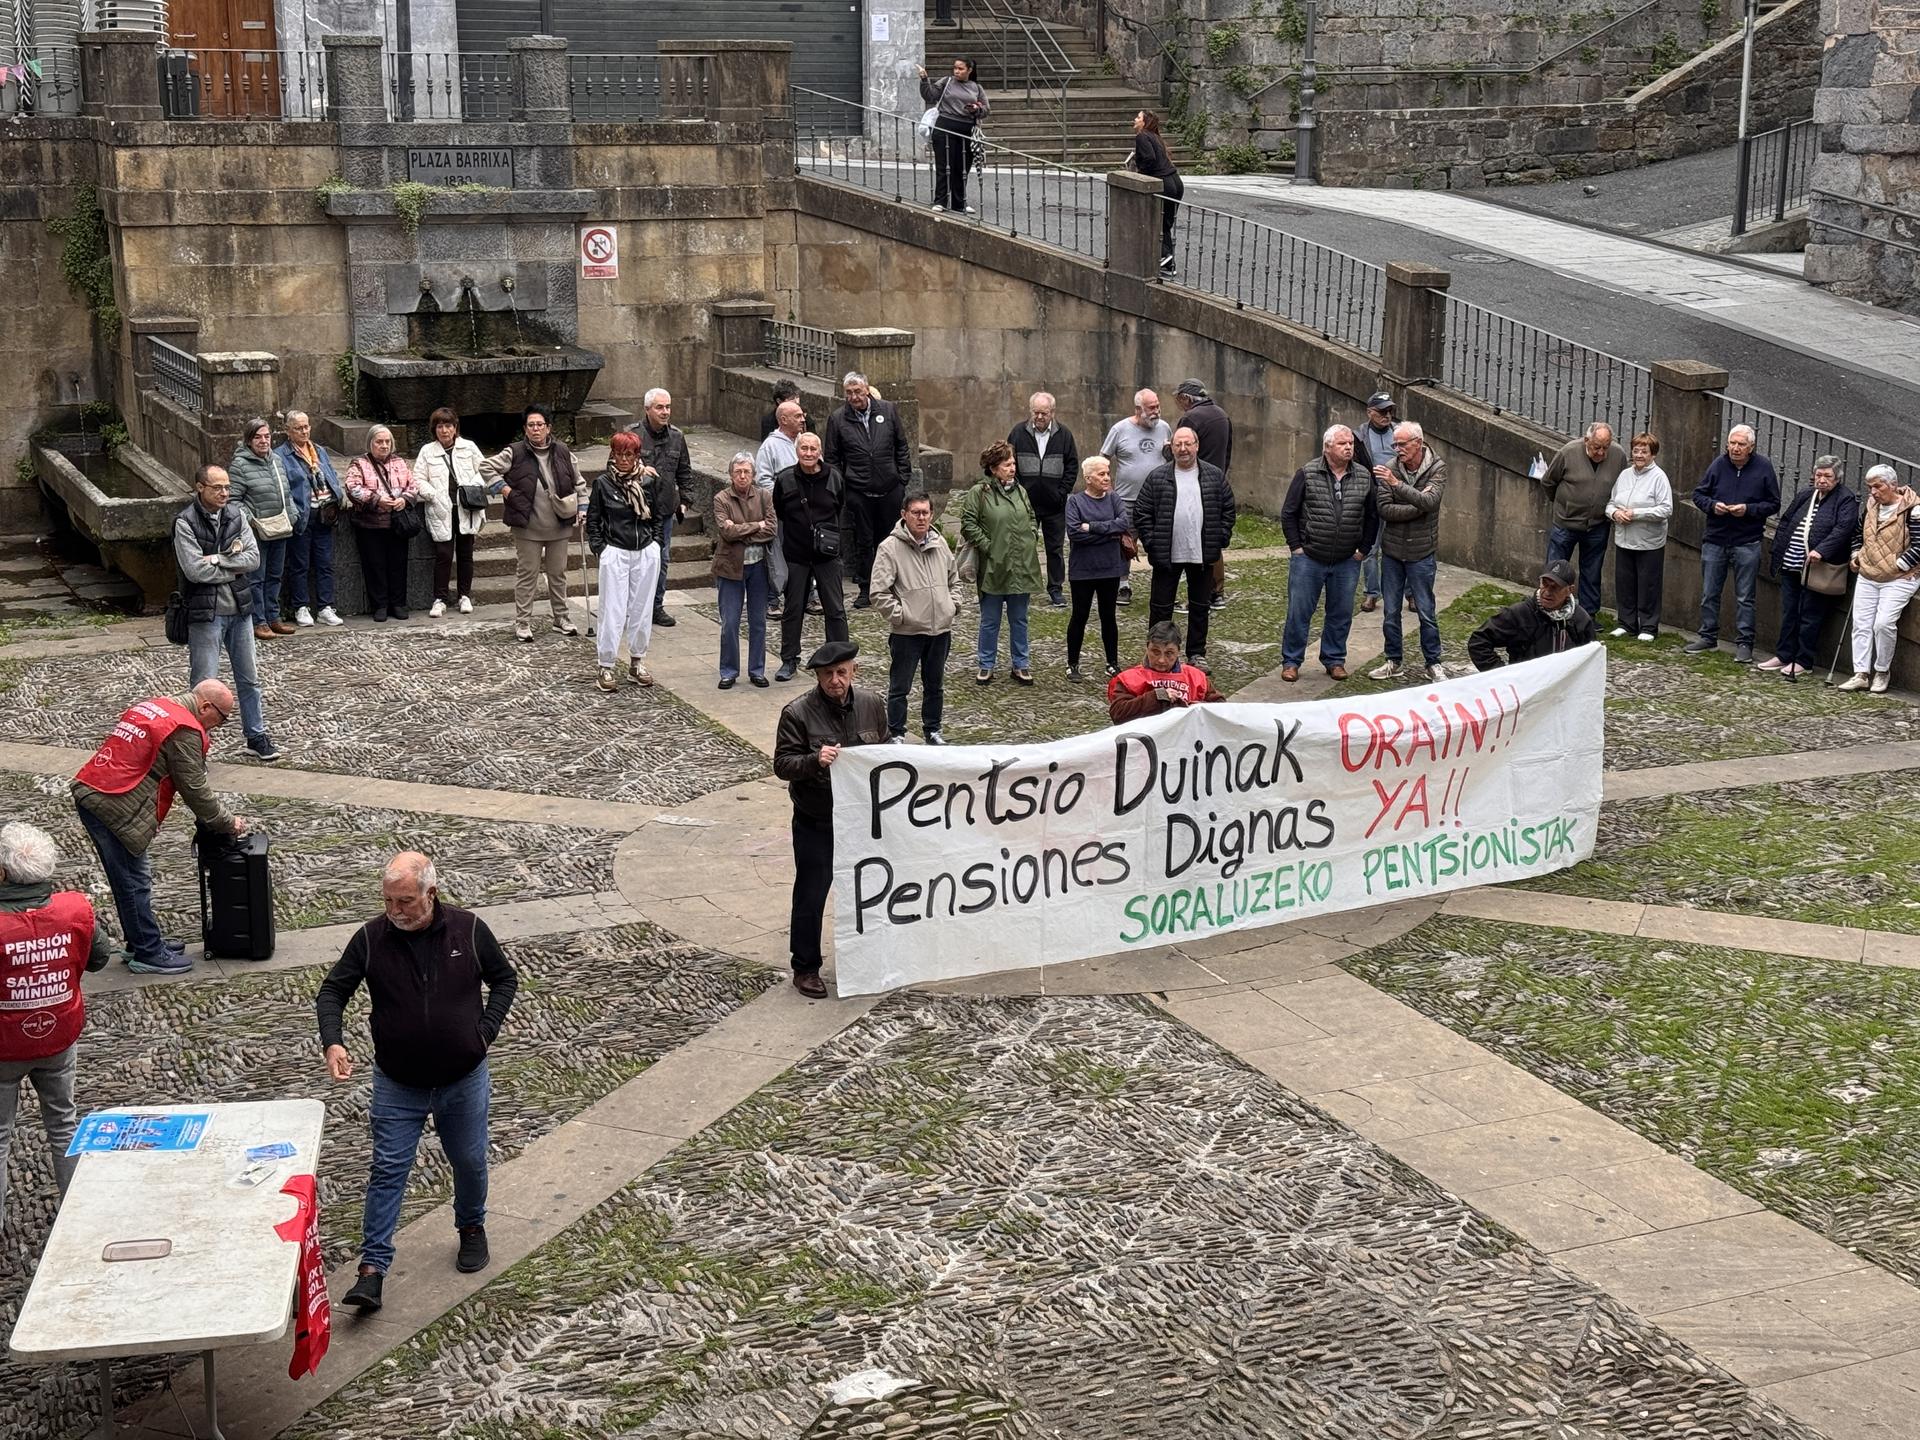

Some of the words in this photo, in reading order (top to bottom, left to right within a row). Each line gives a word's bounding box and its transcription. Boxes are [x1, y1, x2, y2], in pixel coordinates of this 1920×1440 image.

[410, 151, 452, 169] PLAZA
[456, 151, 510, 168] BARRIXA
[869, 757, 1086, 839] Pentsio
[854, 841, 1131, 935] Pensiones
[1165, 799, 1335, 880] Dignas
[1364, 767, 1470, 839] YA!!
[1119, 860, 1333, 944] SORALUZEKO
[5, 933, 72, 955] PENSIÓN
[12, 947, 69, 966] MÍNIMA
[6, 969, 71, 988] SALARIO
[11, 982, 68, 1000] MÍNIMO
